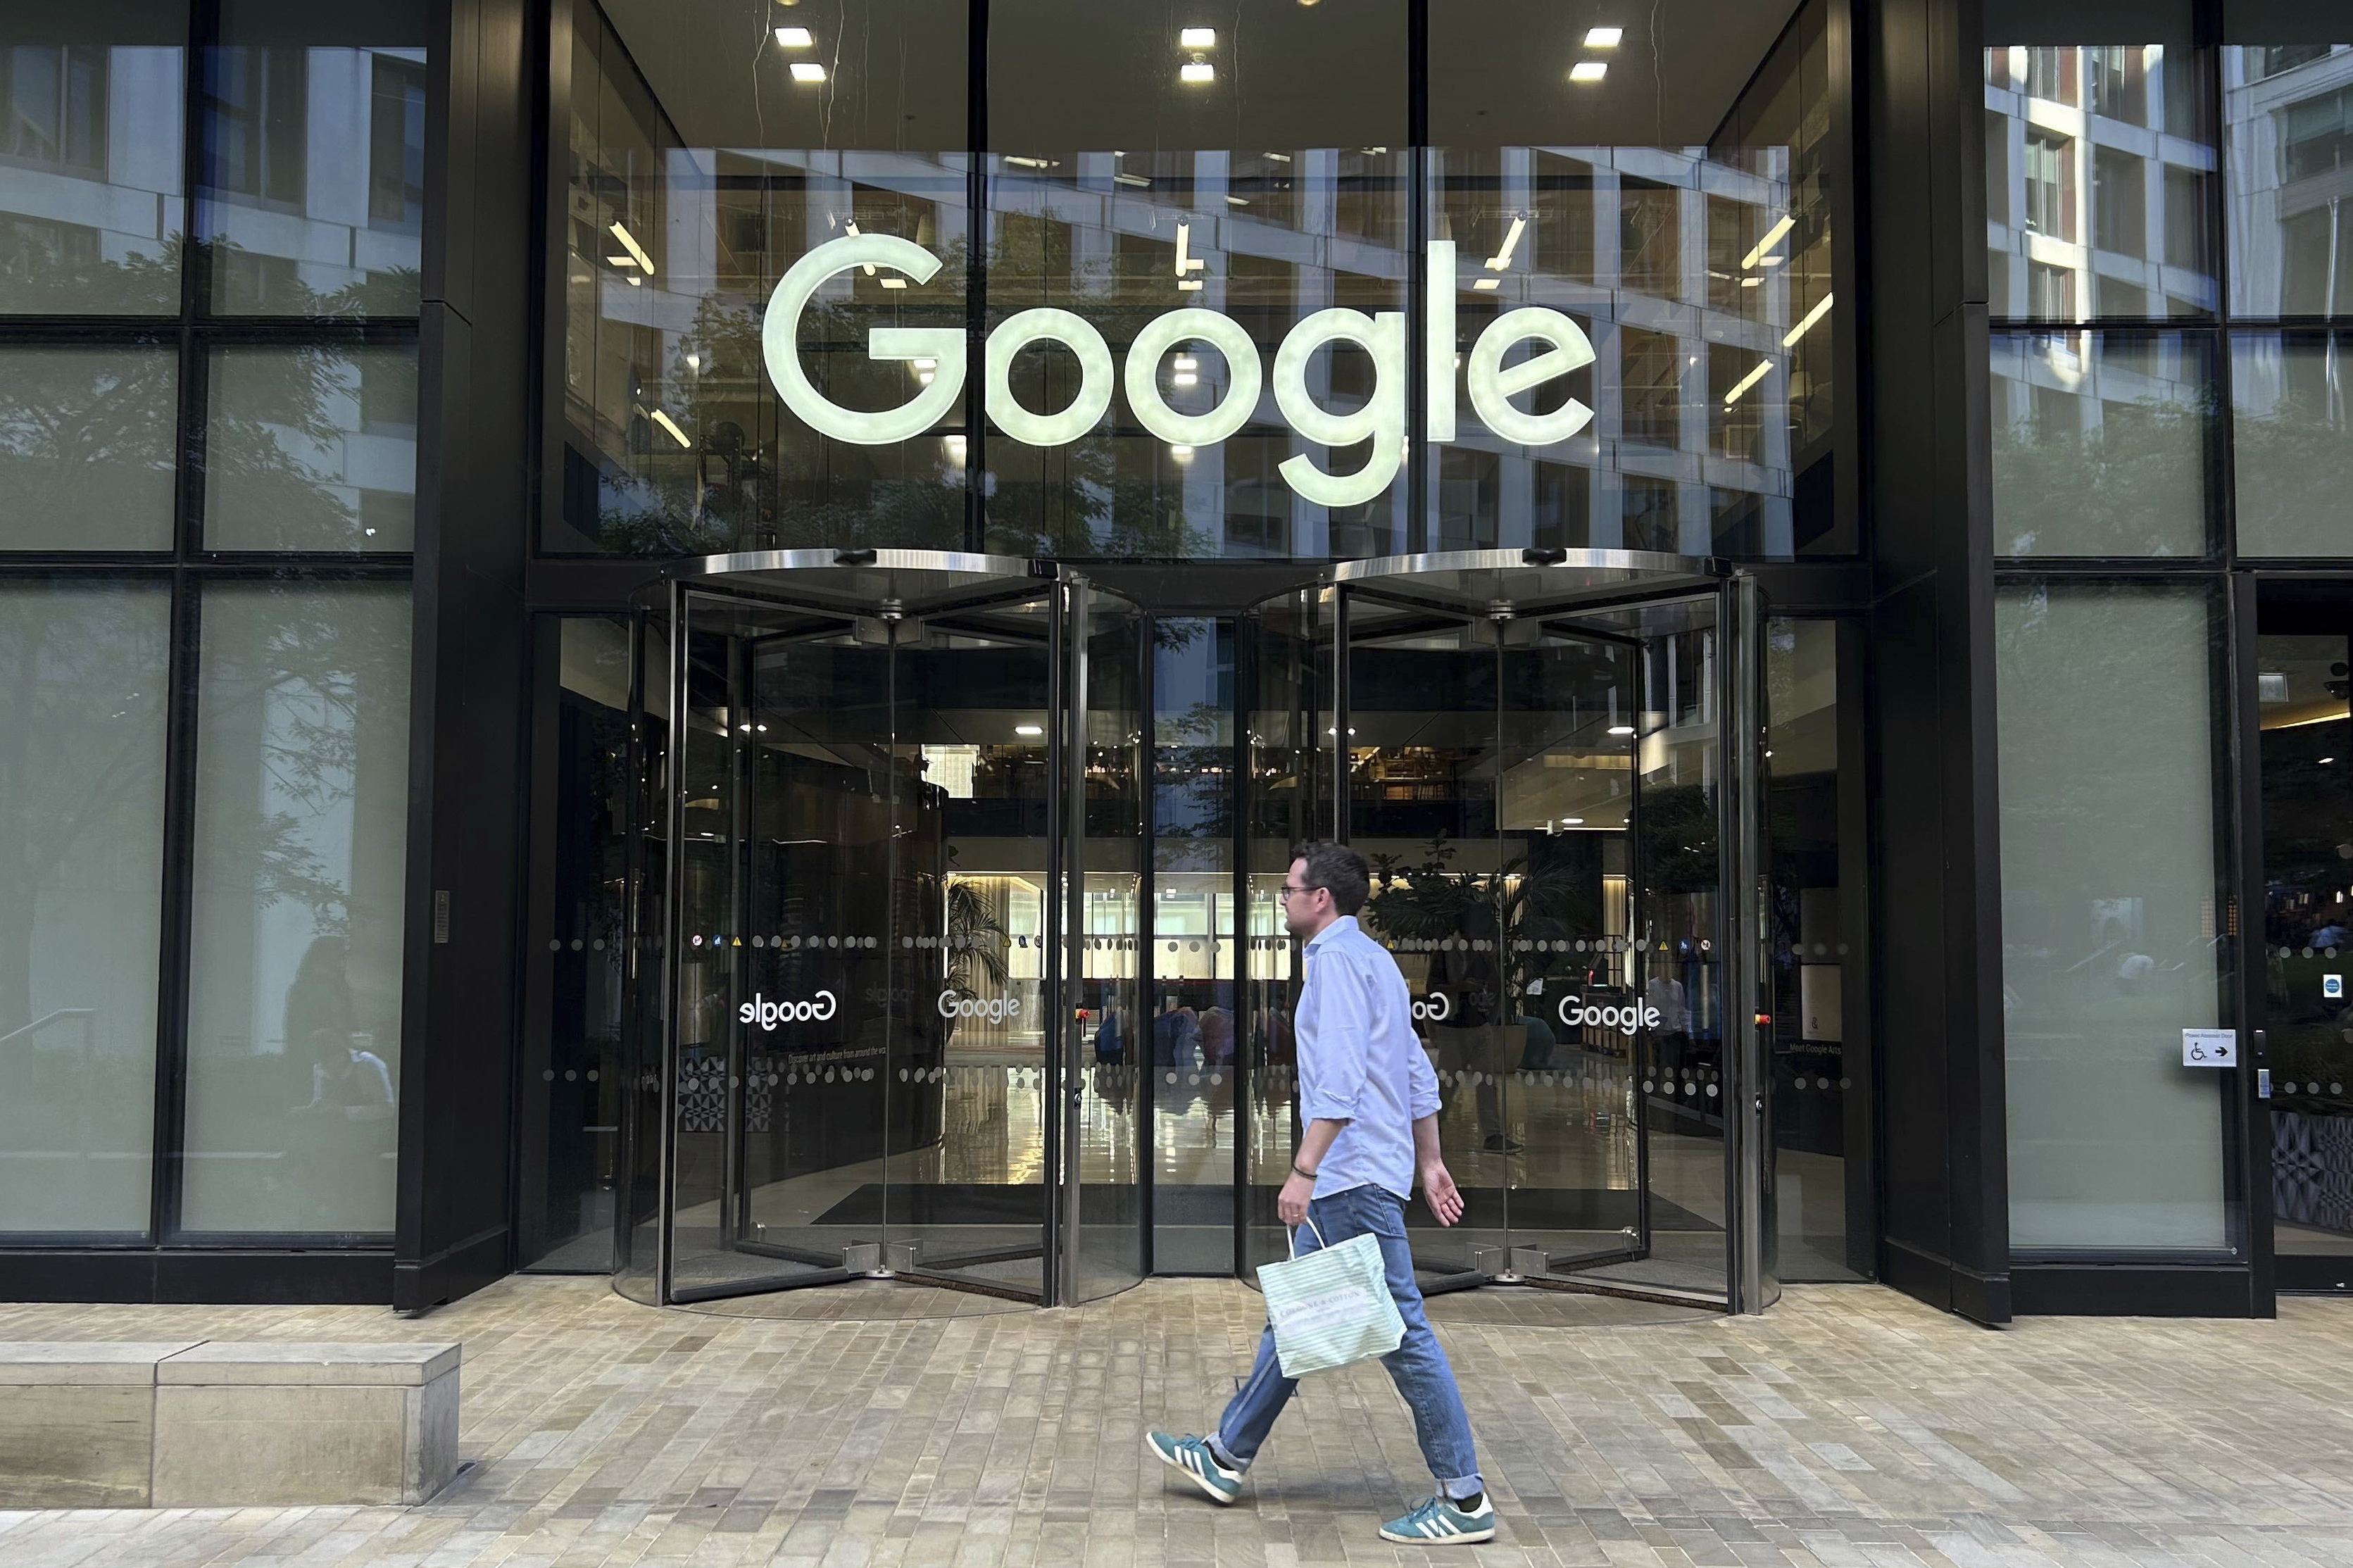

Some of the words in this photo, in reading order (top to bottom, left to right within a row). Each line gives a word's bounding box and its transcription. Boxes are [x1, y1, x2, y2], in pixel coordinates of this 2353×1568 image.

[763, 234, 1595, 508] Google
[937, 989, 1021, 1025] Google
[1558, 995, 1661, 1036] Google
[817, 1050, 826, 1061] and
[843, 1048, 854, 1058] from
[855, 1046, 870, 1057] around
[1790, 1043, 1805, 1052] Meet
[1806, 1044, 1828, 1055] Google
[1828, 1046, 1842, 1055] Arts
